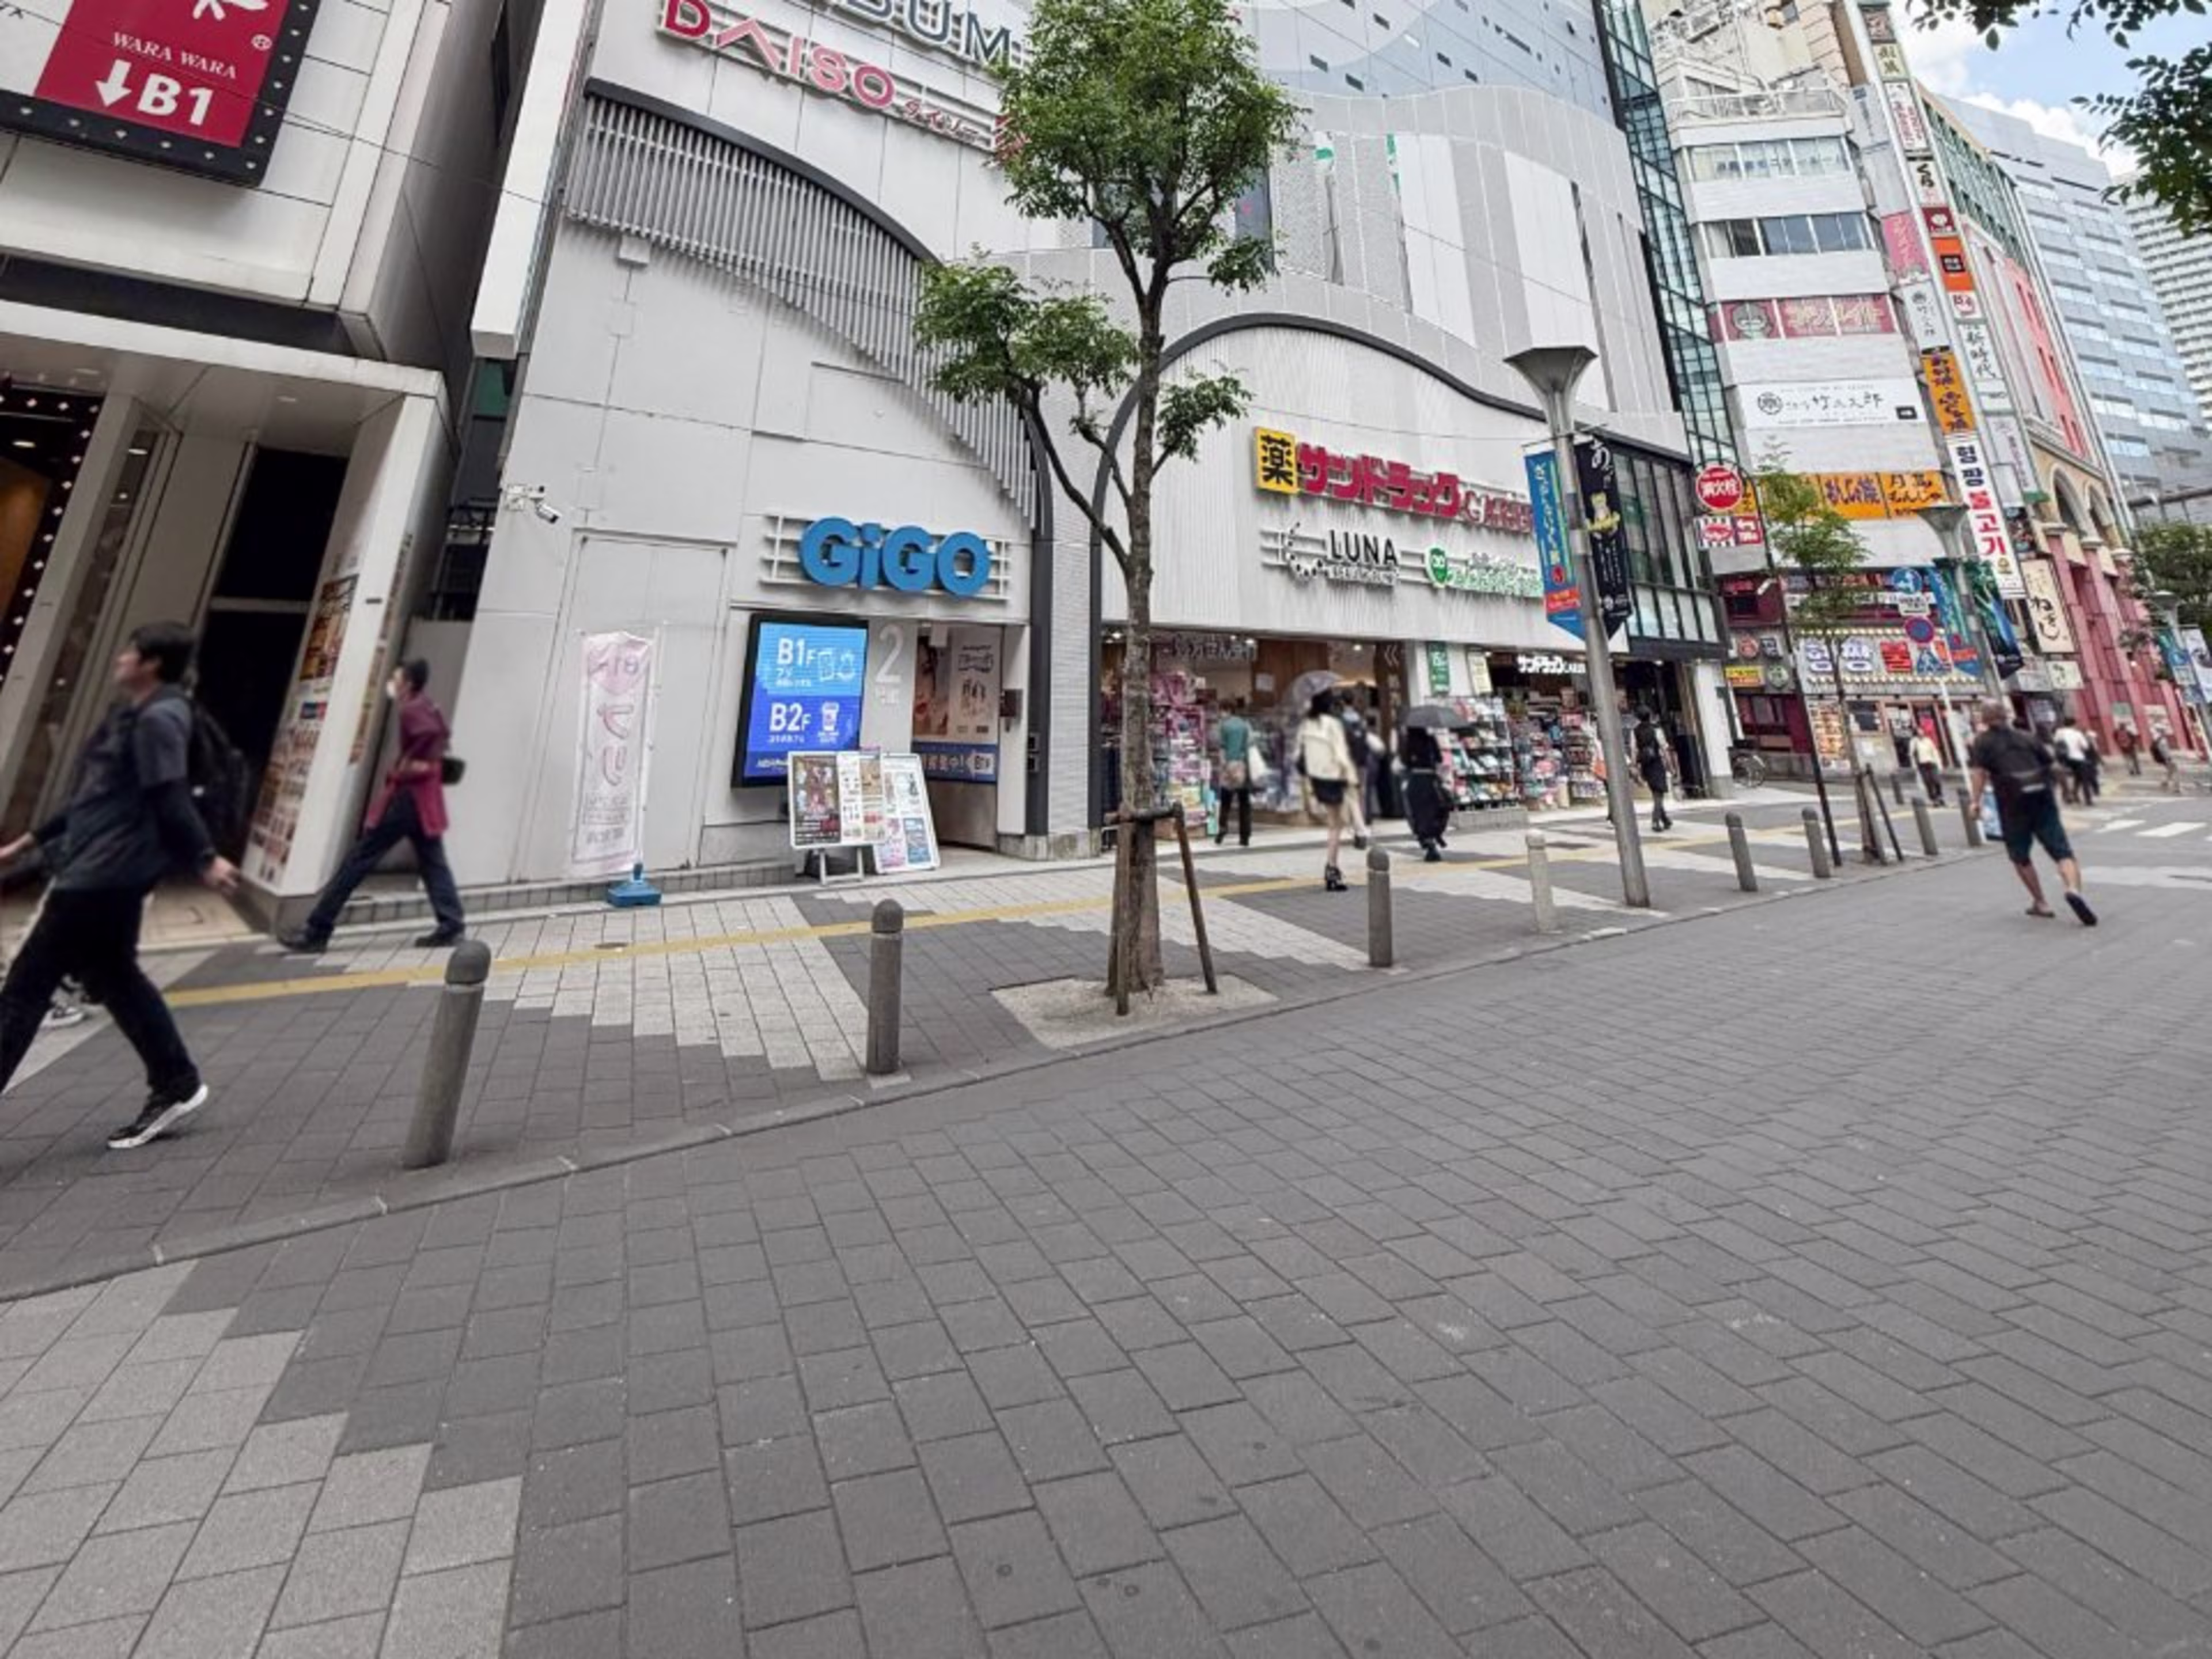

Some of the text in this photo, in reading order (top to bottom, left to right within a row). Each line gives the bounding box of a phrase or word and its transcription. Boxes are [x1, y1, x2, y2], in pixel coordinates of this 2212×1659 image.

[113, 31, 236, 79] WARA WARA
[664, 0, 895, 107] DAISO
[137, 73, 213, 126] B1
[1260, 434, 1294, 486] 薬
[1297, 442, 1461, 518] サンドラッグ
[800, 517, 991, 597] GiGO
[1330, 529, 1399, 566] LUNA
